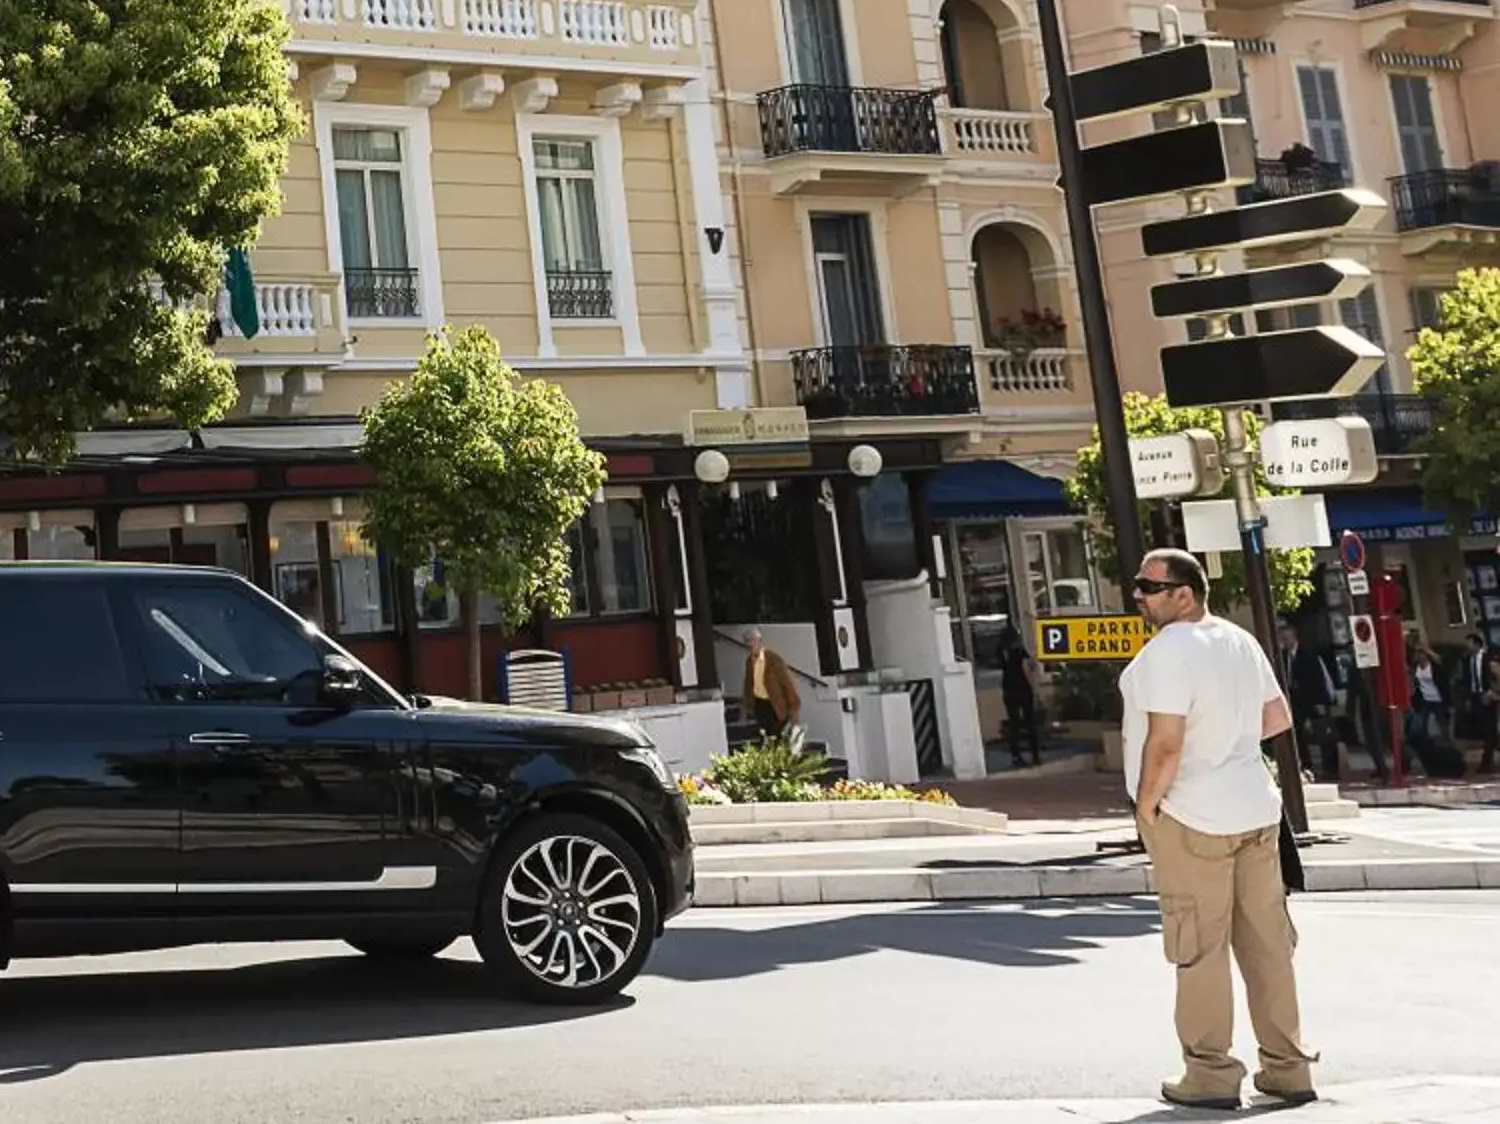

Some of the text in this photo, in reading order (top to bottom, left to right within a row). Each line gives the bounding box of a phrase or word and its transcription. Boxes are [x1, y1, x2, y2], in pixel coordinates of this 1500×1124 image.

[1290, 435, 1318, 449] Rue
[1138, 450, 1173, 461] Avenue
[1267, 457, 1349, 475] de la Colle
[1087, 620, 1154, 636] PARKIN
[1075, 639, 1132, 654] GRAND
